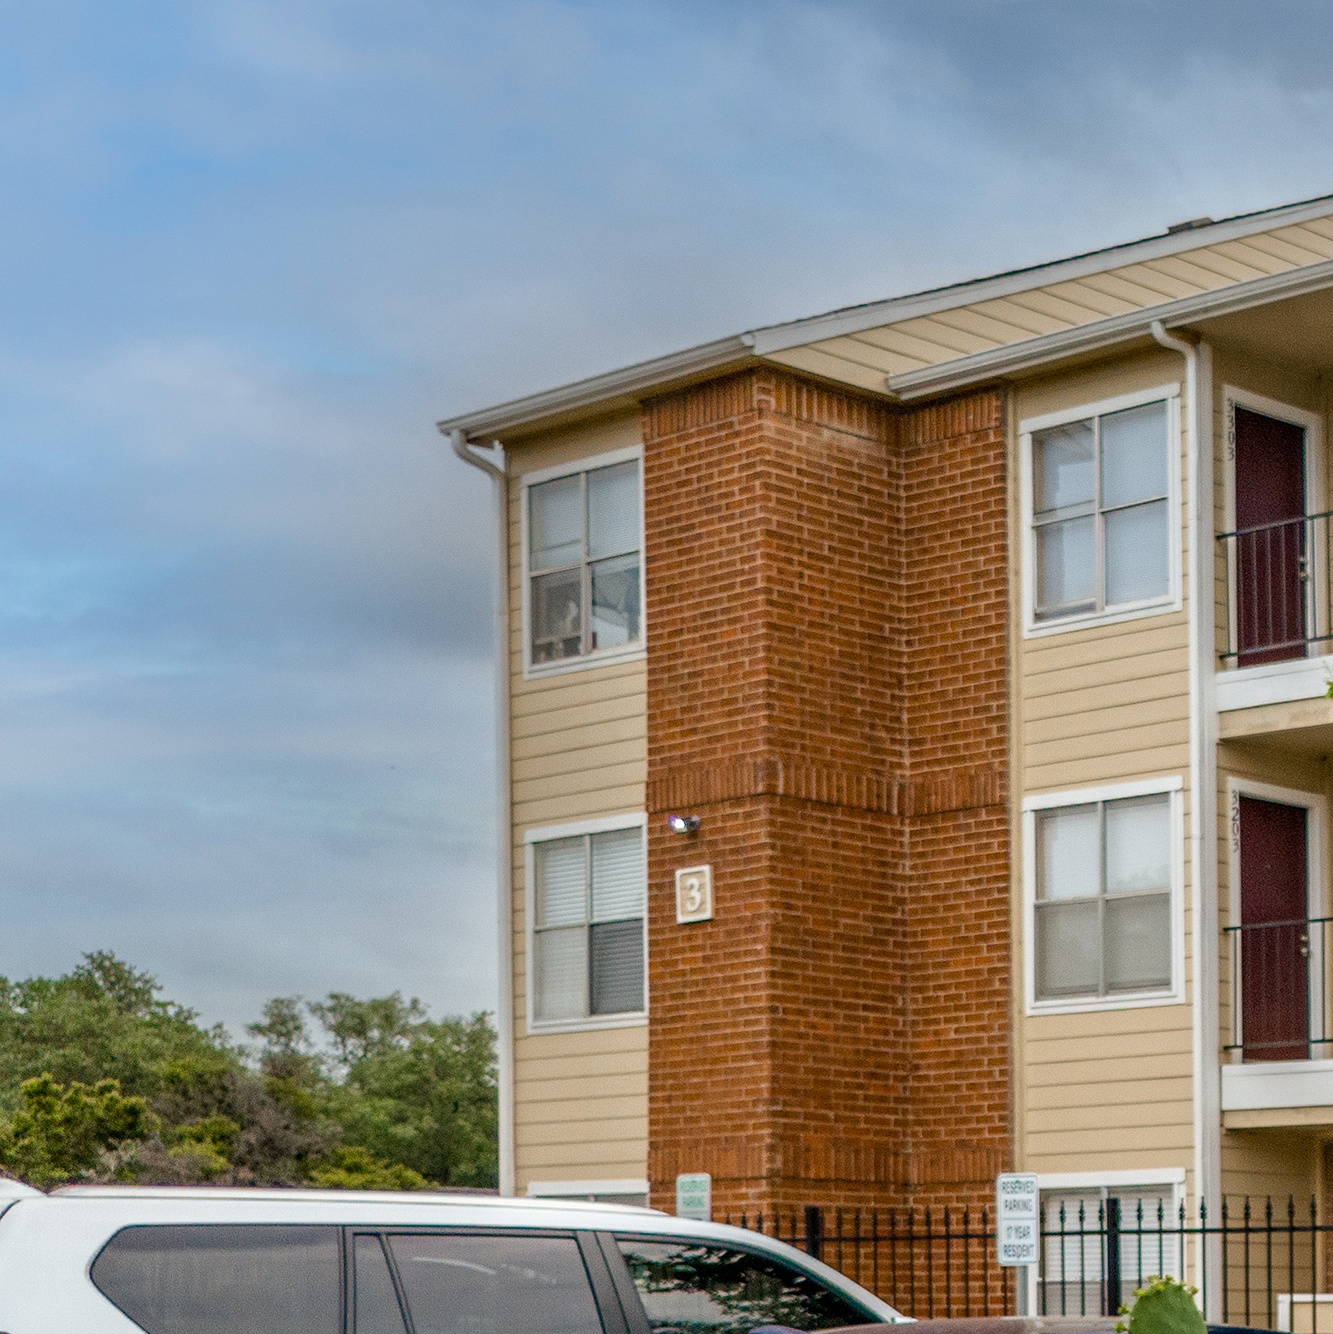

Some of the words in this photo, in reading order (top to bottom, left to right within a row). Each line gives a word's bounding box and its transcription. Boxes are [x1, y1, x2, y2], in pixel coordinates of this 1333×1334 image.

[1231, 789, 1240, 853] 3203
[686, 878, 701, 912] 3
[1002, 1180, 1035, 1194] RESERVED
[1004, 1199, 1033, 1212] PARKING
[1003, 1244, 1035, 1258] RESIDENT
